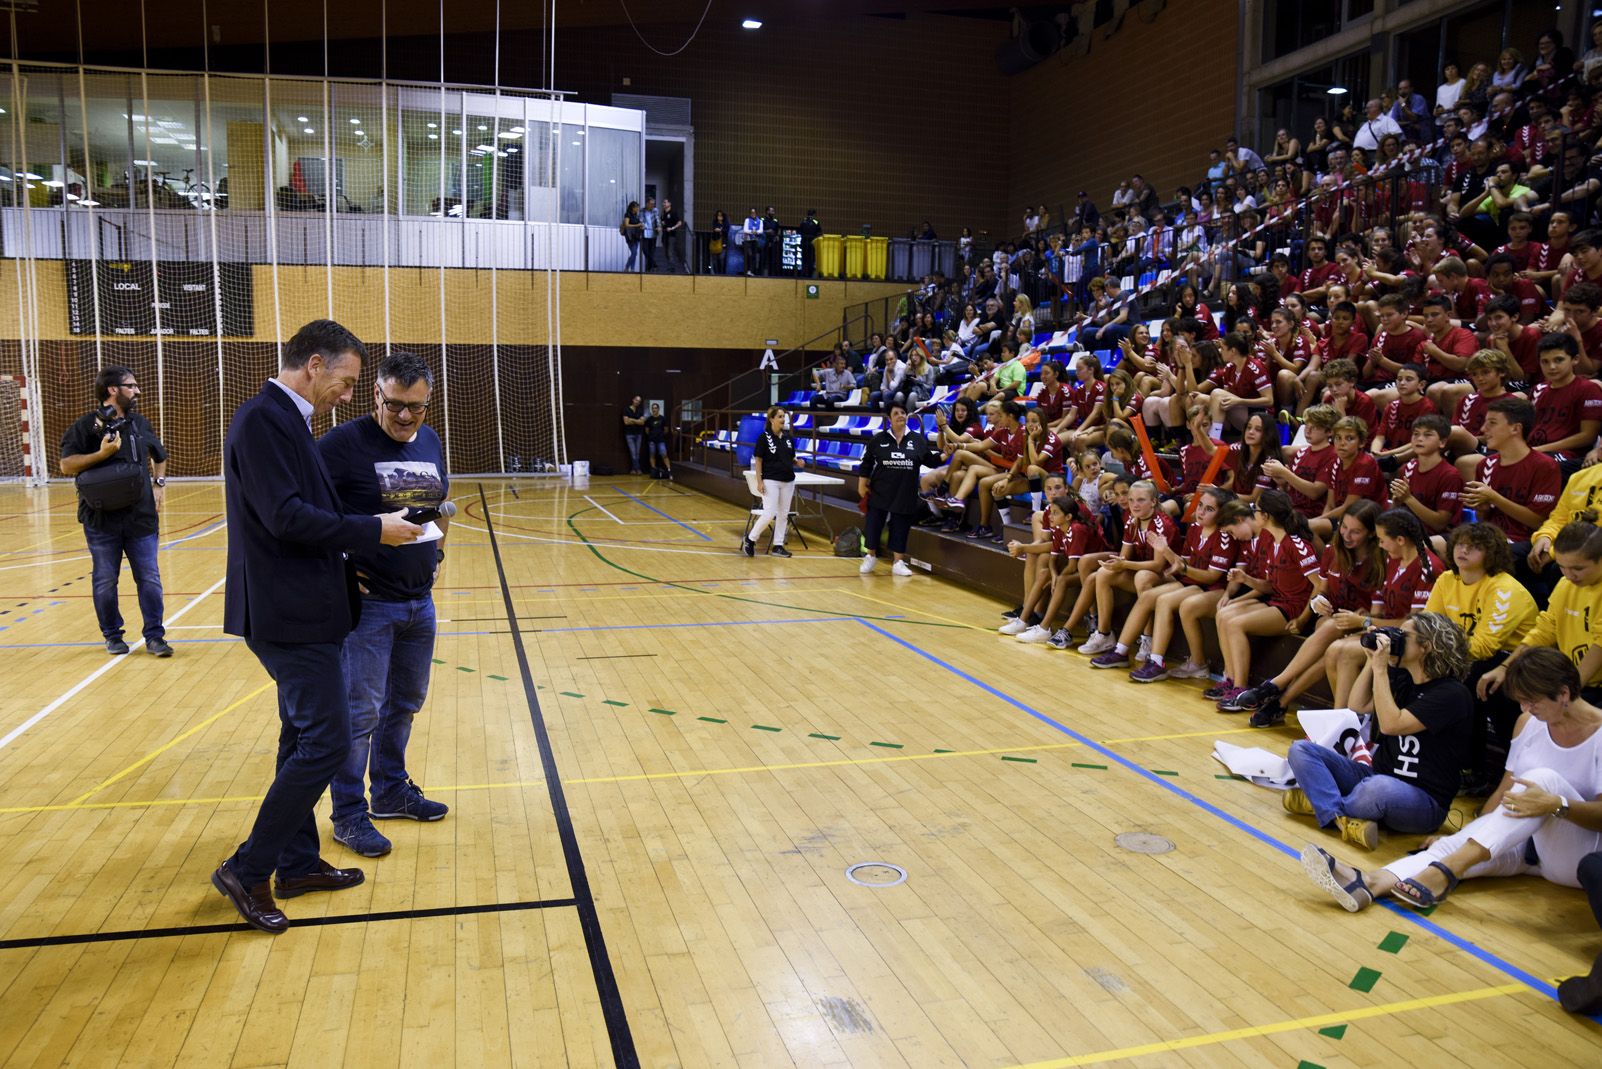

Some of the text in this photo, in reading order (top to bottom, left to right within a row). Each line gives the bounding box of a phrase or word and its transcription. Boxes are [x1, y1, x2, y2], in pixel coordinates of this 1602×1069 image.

[183, 284, 207, 292] VISITANT
[759, 348, 779, 370] A
[882, 459, 914, 467] moventis
